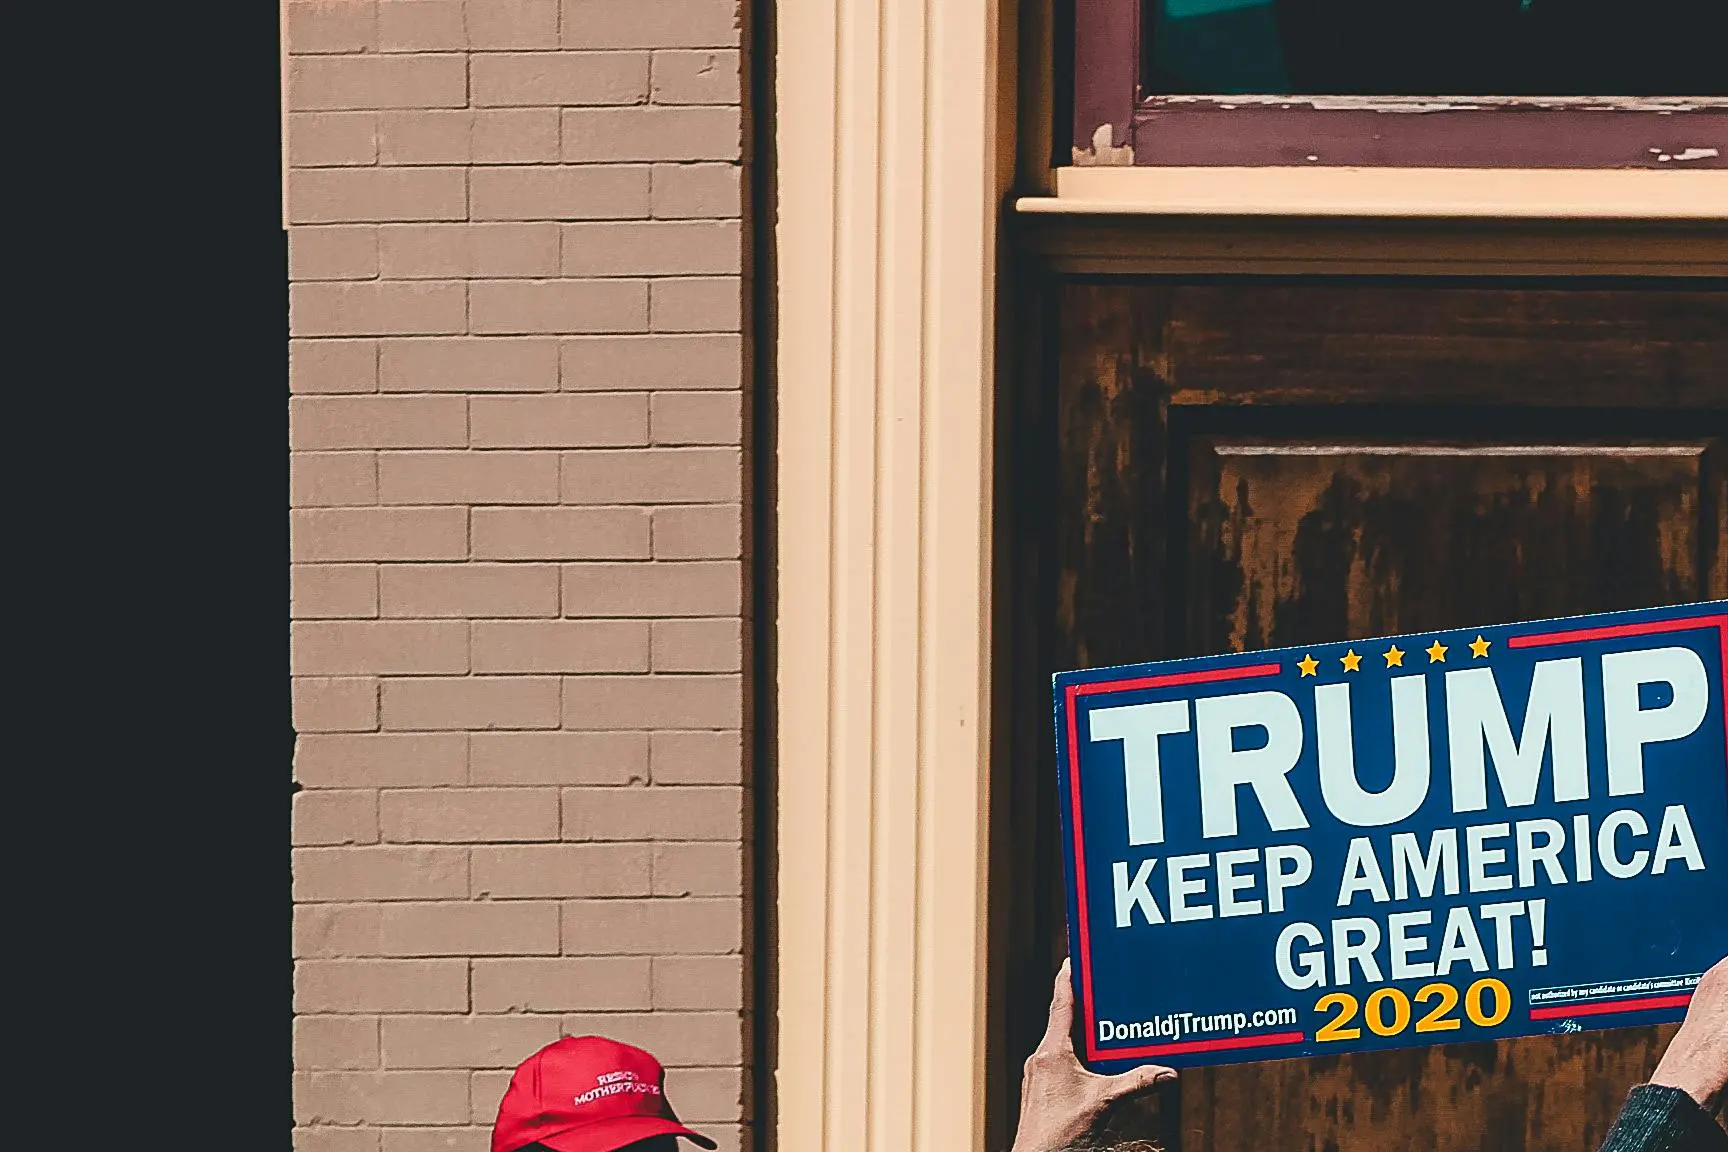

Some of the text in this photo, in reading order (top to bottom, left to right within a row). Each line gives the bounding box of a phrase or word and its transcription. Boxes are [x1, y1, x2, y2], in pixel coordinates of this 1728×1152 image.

[1088, 645, 1710, 846] TRUMP
[1111, 804, 1706, 929] KEEP AMERICA
[1274, 899, 1549, 991] GREAT!
[1097, 1004, 1297, 1042] DonaldjTrump.com
[1313, 977, 1512, 1043] 2020
